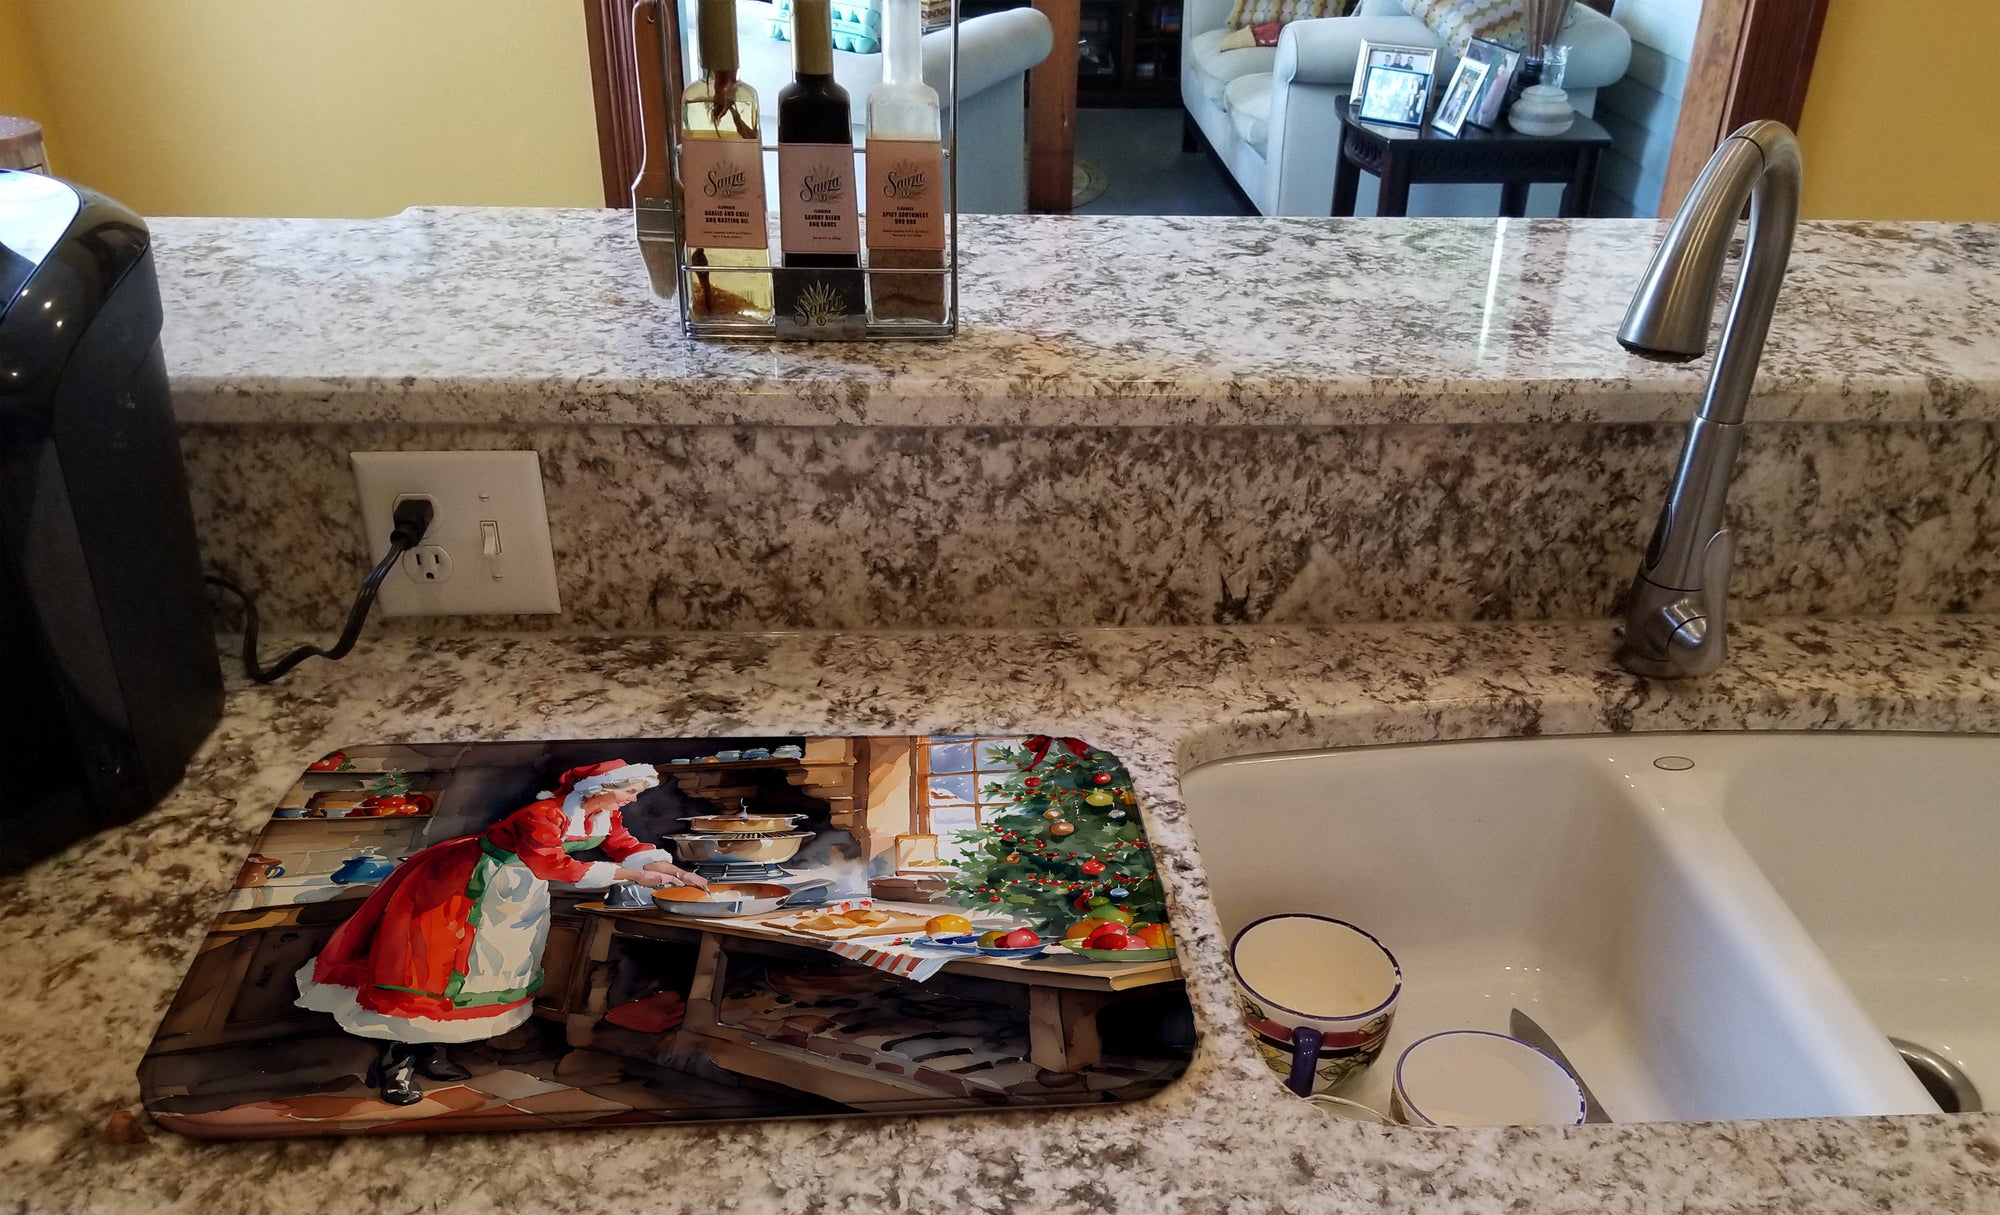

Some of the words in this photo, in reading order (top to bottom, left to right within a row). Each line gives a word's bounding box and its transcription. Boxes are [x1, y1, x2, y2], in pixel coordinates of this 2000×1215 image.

[704, 170, 746, 197] Sauza
[800, 175, 841, 202] Sauza
[884, 171, 924, 198] Sauza
[793, 295, 843, 327] Sauza
